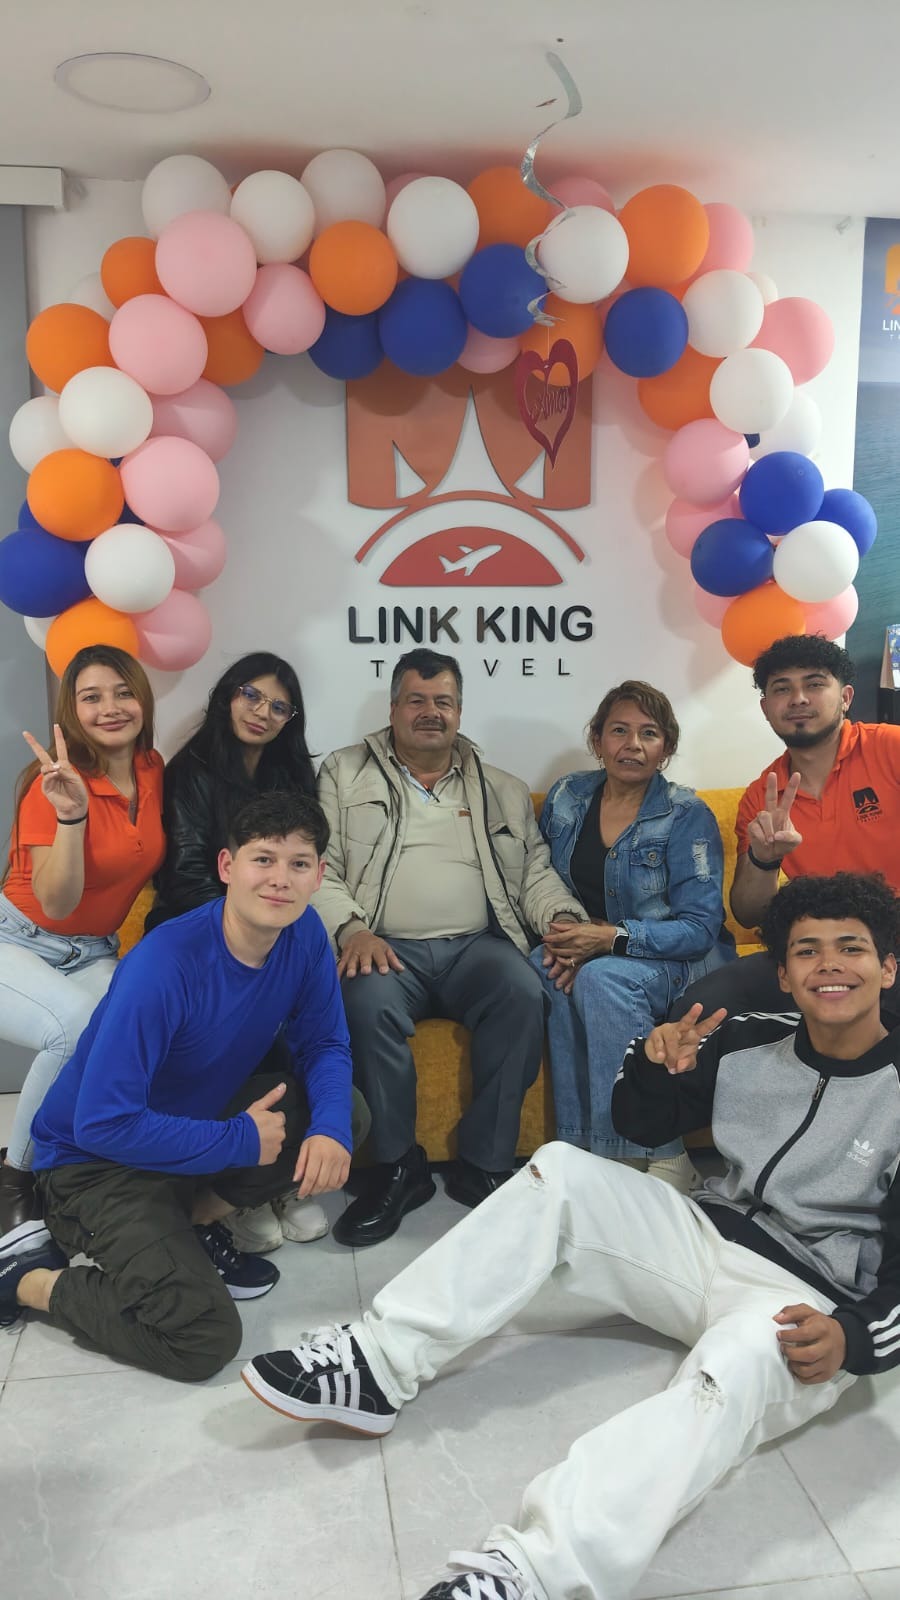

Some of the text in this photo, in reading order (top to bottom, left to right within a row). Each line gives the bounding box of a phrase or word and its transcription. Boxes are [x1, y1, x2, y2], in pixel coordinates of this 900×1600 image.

[348, 605, 593, 643] LINK KING
[370, 658, 570, 677] TVEL
